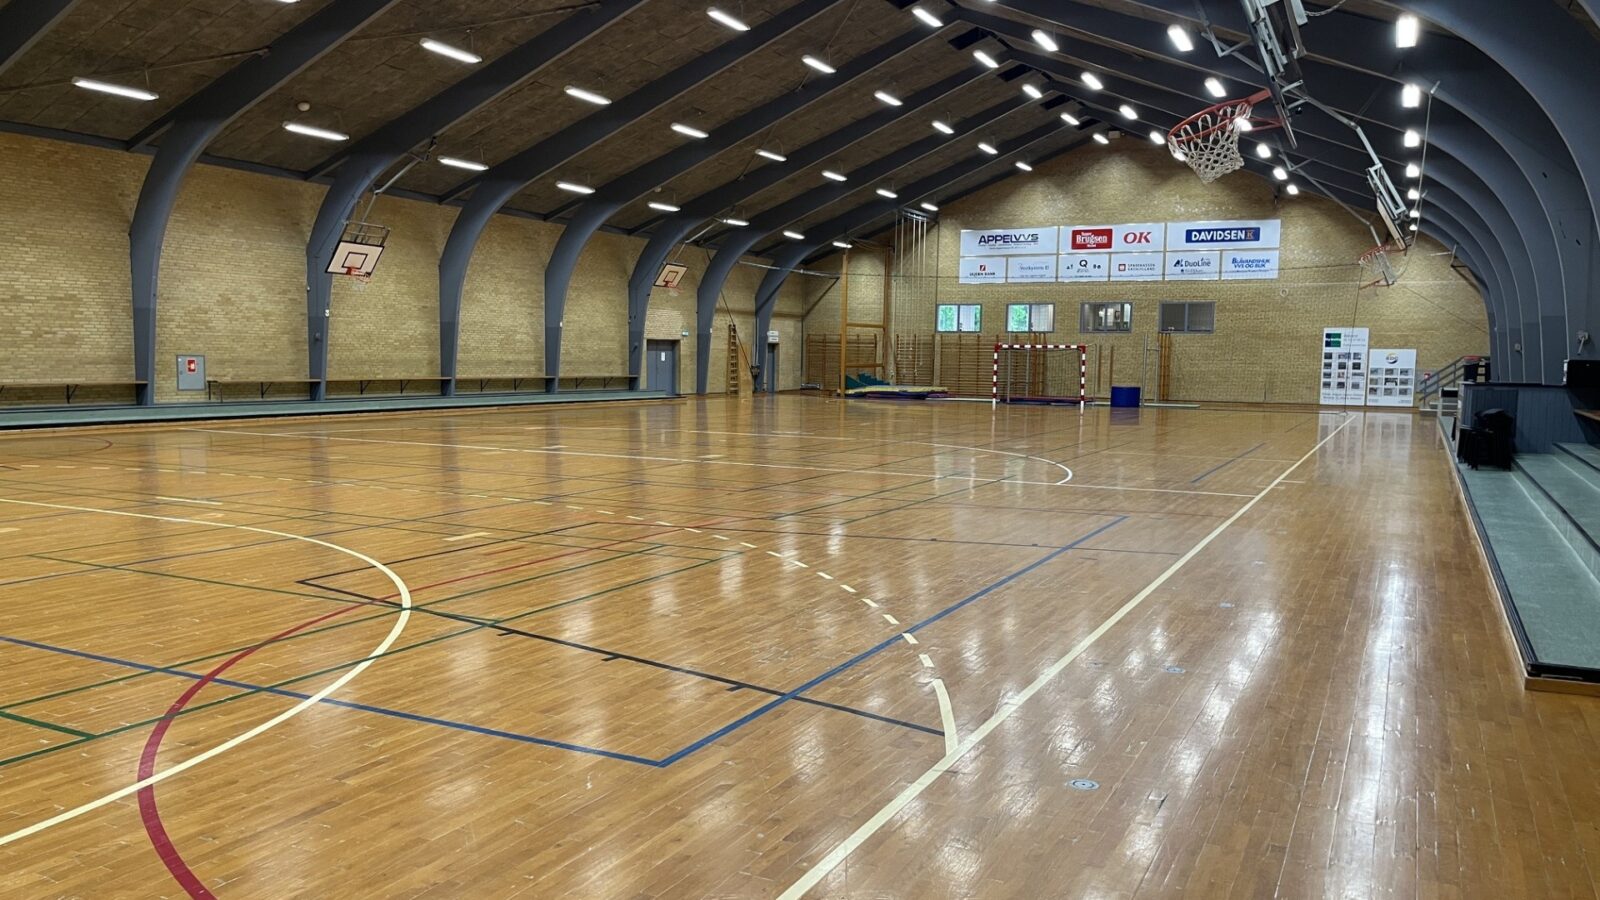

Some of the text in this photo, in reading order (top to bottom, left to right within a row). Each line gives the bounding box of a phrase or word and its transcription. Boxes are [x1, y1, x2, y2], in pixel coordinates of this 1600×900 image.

[1076, 234, 1108, 245] Brugsen
[1123, 231, 1152, 244] OK
[1191, 229, 1246, 241] DAVIDSEN
